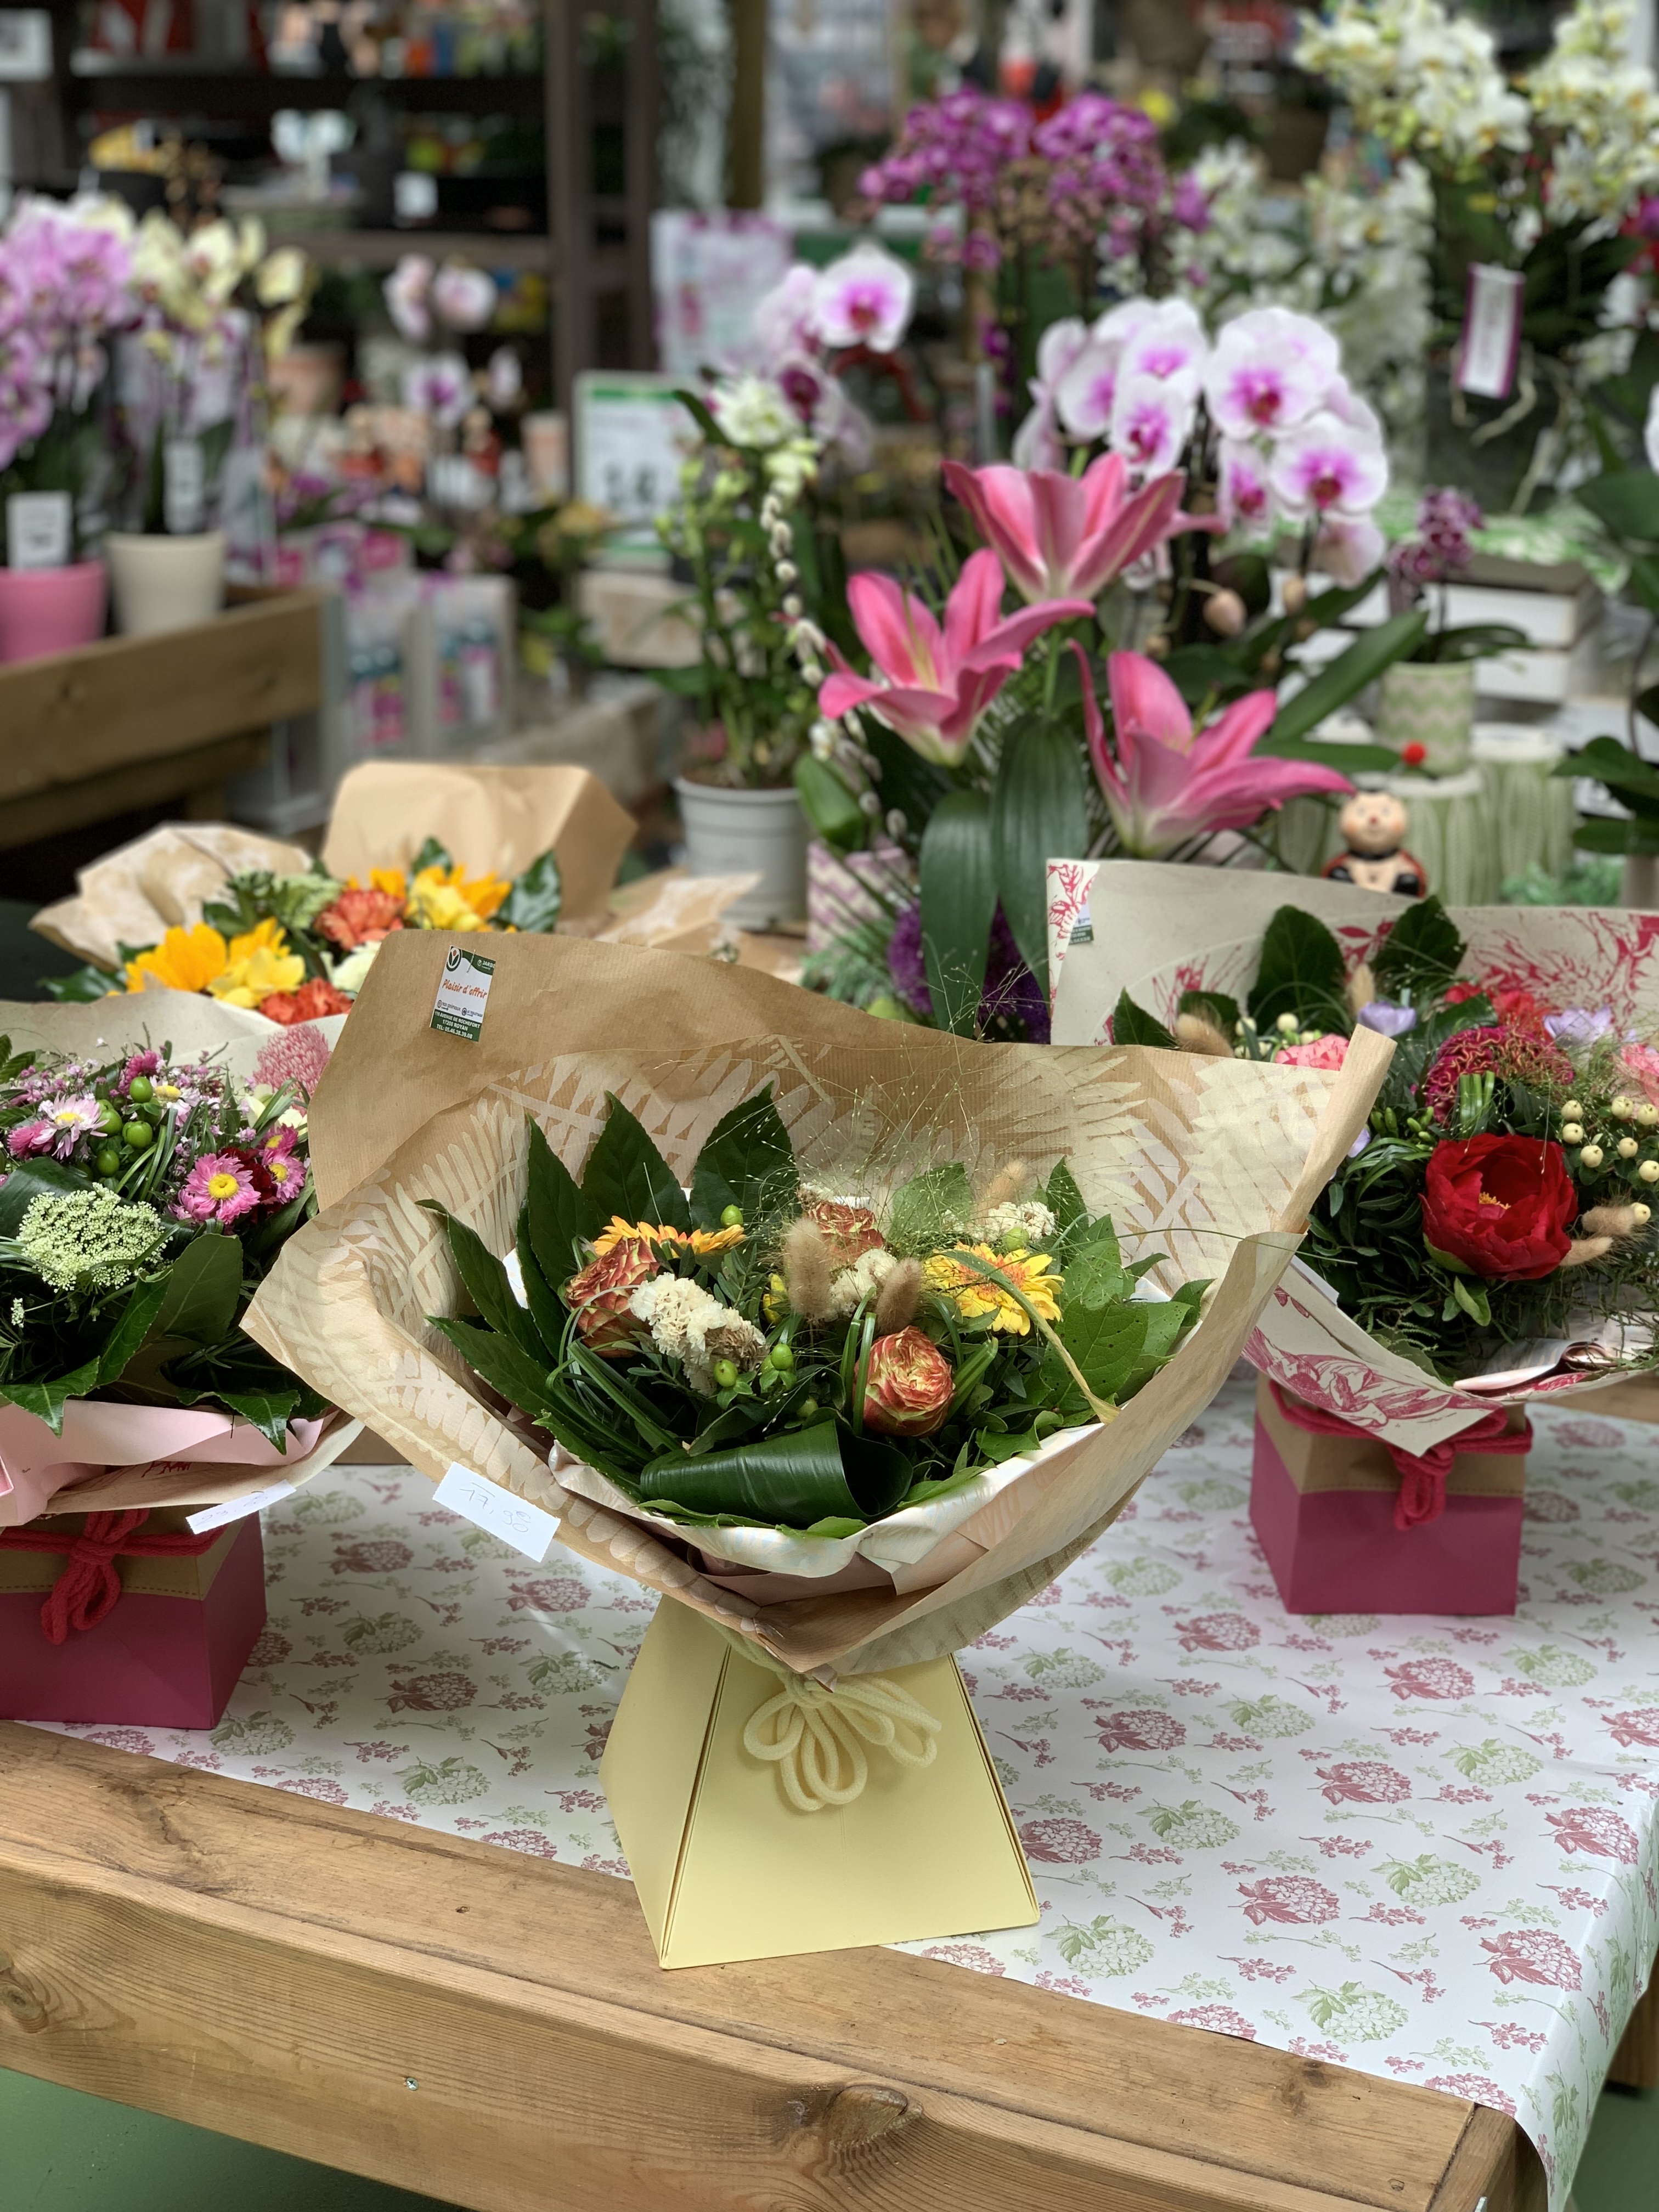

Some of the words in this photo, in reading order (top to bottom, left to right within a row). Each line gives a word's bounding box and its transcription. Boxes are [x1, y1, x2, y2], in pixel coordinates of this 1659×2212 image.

[442, 979, 462, 992] Plaisir
[454, 1023, 469, 1031] ROYAN
[458, 1018, 481, 1029] ROCHEFORT
